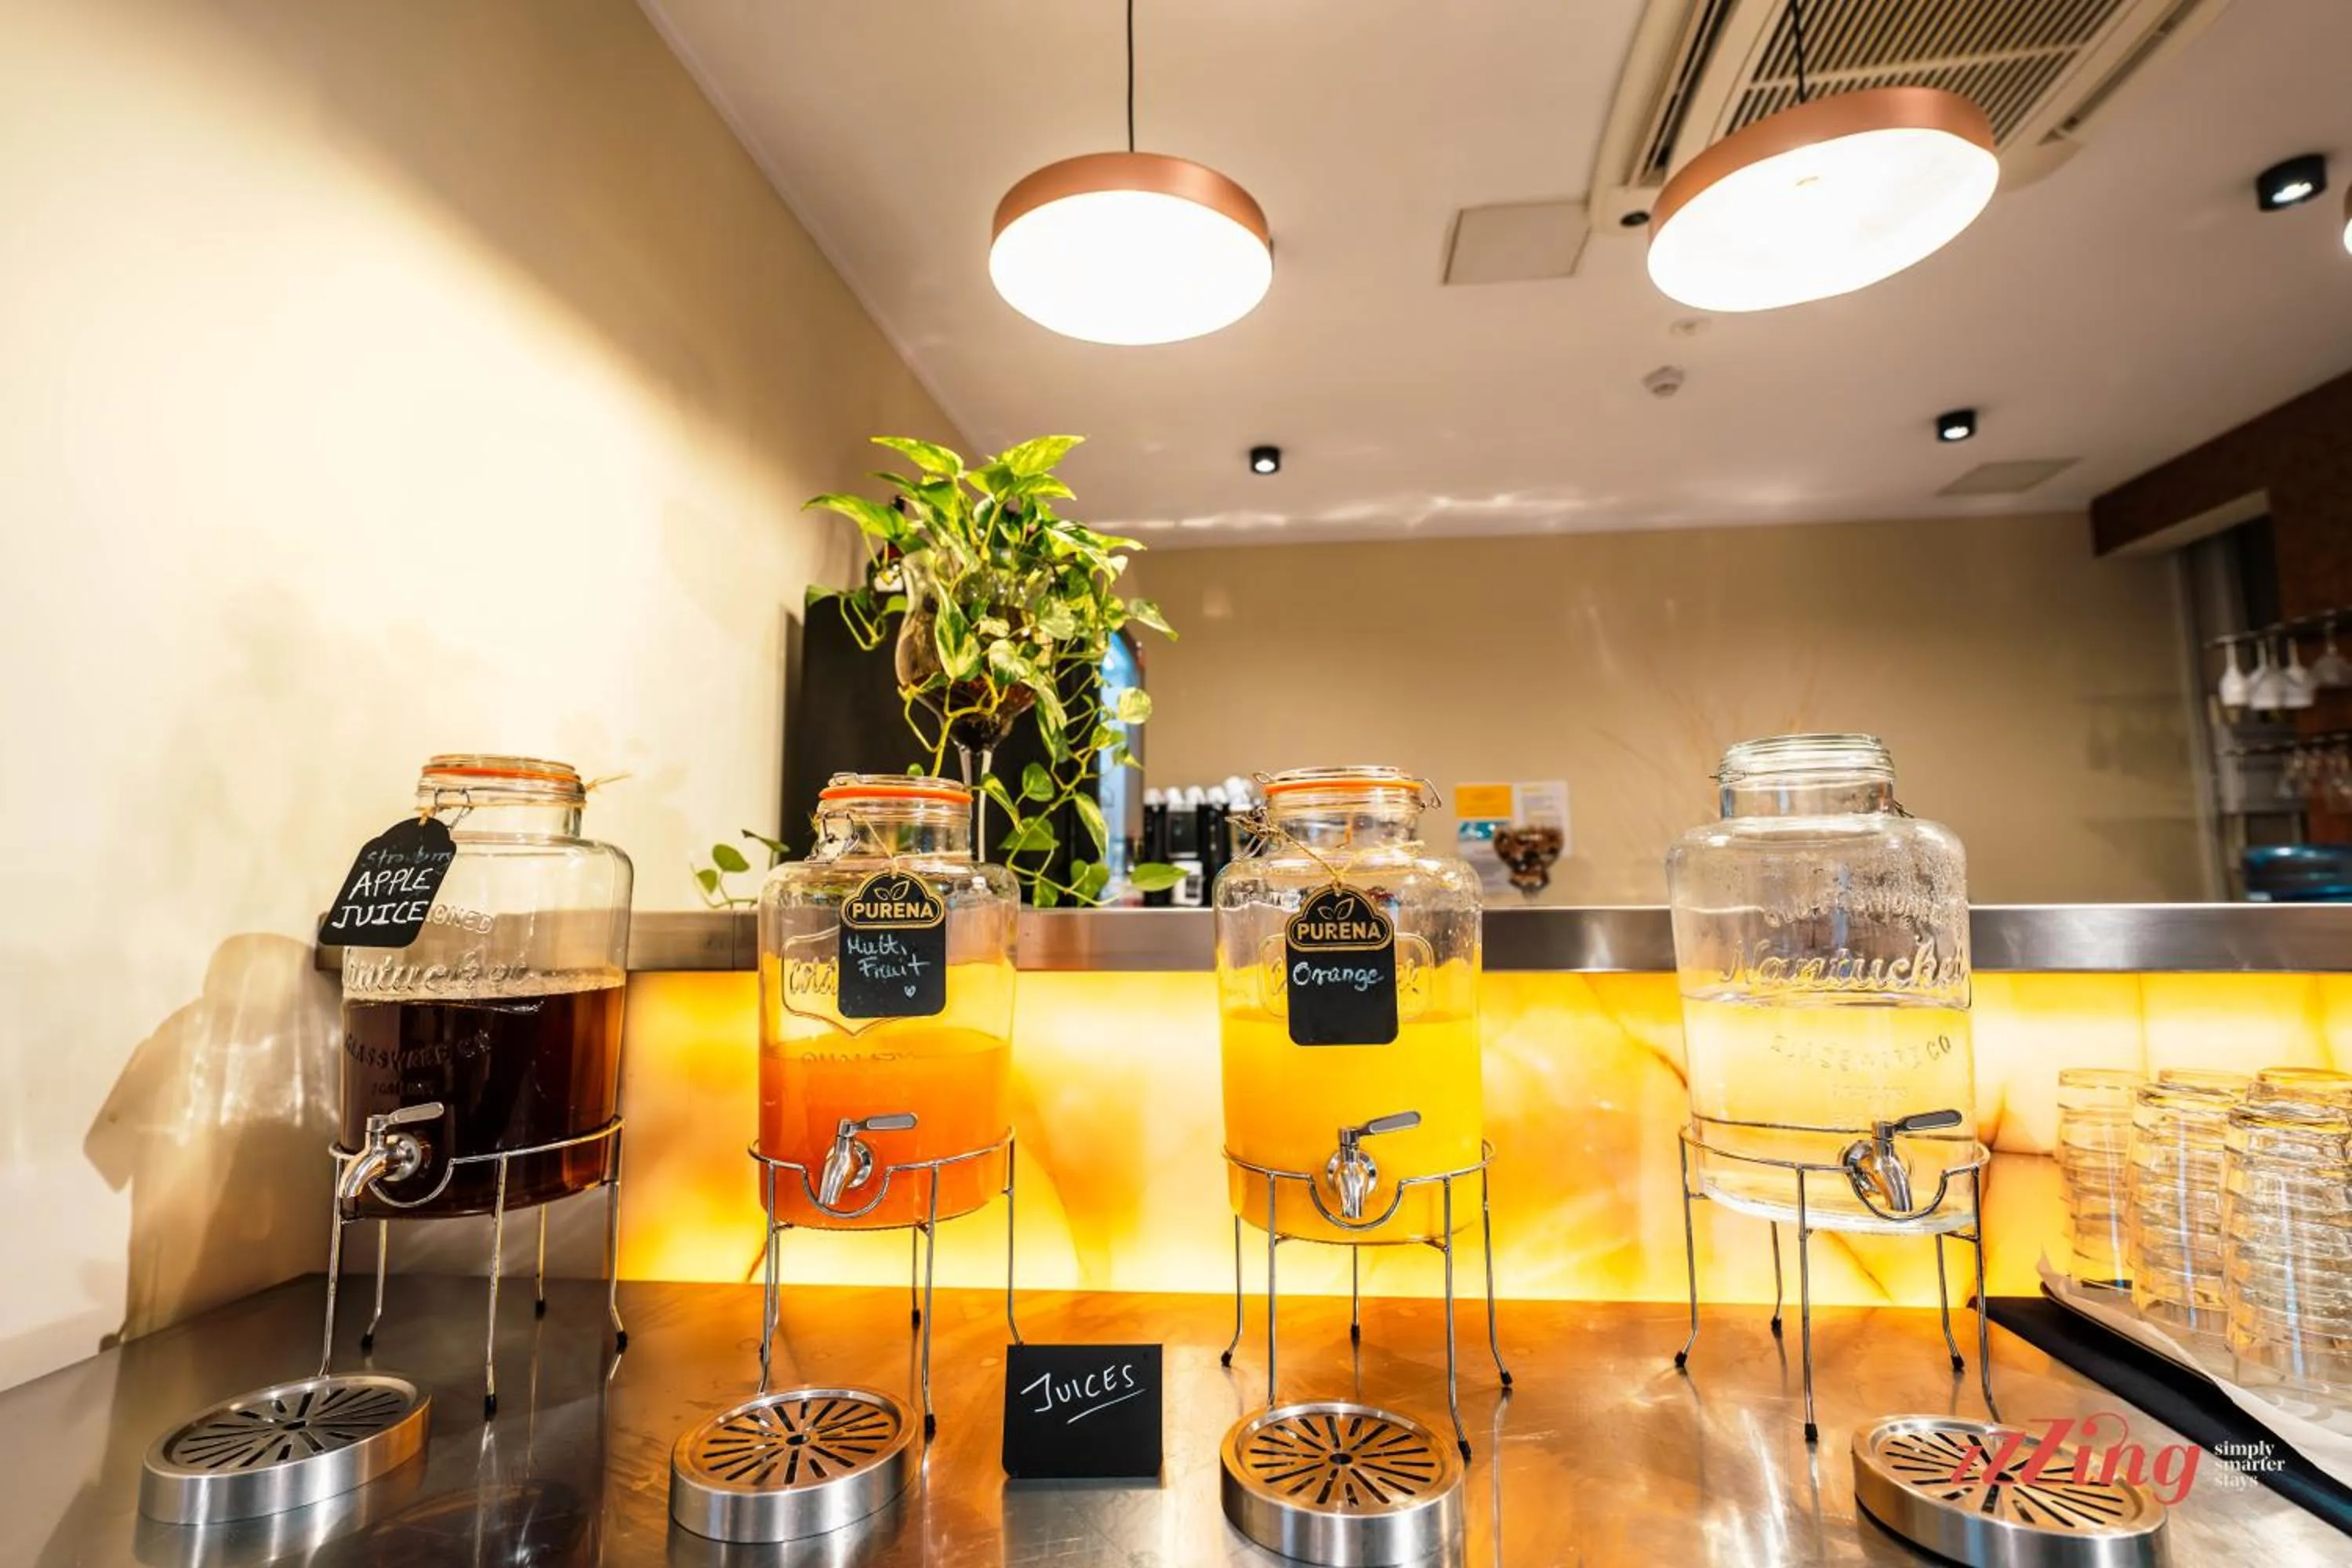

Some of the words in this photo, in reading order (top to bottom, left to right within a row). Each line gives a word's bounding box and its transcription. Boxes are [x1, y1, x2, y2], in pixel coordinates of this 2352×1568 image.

[348, 866, 434, 901] APPLE
[331, 901, 429, 929] JUICE
[851, 902, 935, 919] PURENA
[1297, 923, 1381, 941] PURENA
[857, 953, 931, 980] Fruit
[1292, 961, 1385, 993] Orange
[1020, 1364, 1135, 1413] JUICES
